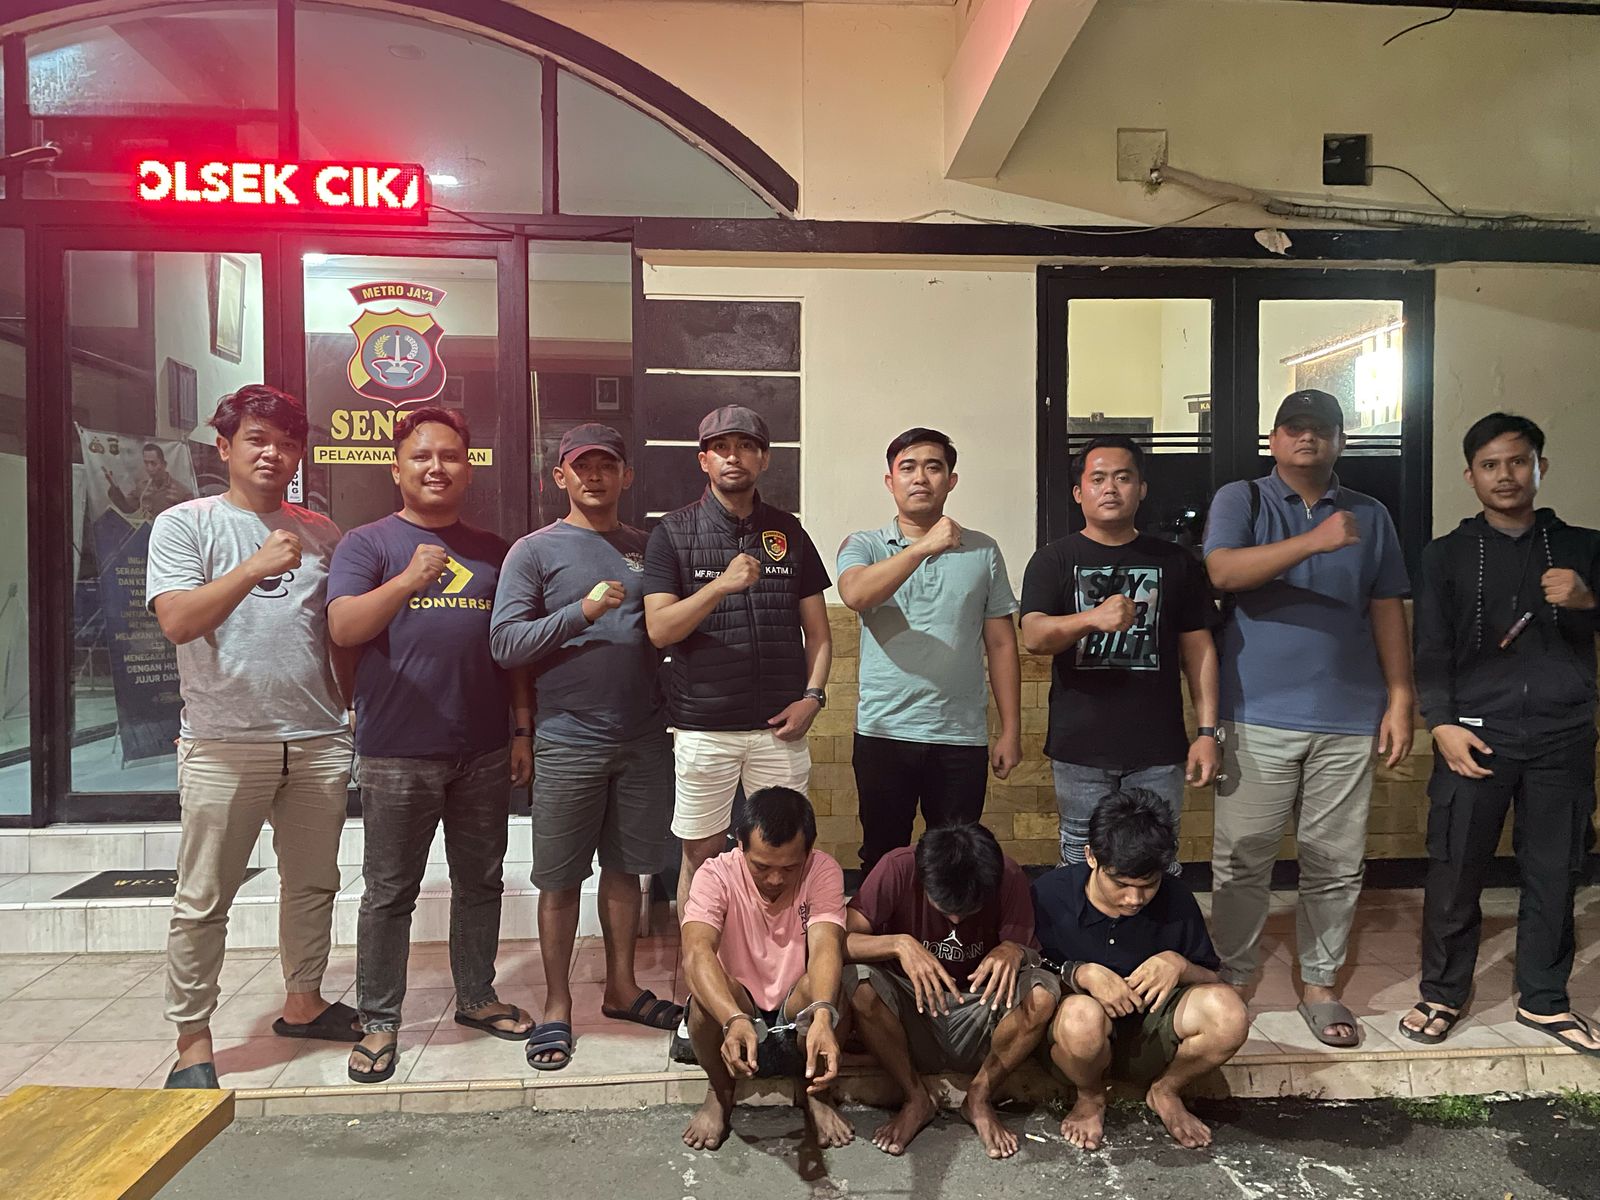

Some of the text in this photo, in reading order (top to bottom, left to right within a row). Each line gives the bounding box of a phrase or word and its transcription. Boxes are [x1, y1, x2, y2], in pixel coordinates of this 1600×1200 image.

[362, 285, 433, 302] METRO JAYA
[331, 409, 415, 441] SEN
[468, 451, 486, 462] AN
[291, 473, 299, 494] ONG
[765, 566, 789, 575] KATIM
[1087, 572, 1149, 601] SPY
[409, 597, 492, 610] CONVERSE
[127, 664, 161, 674] DENGAN
[134, 675, 160, 685] JUJUR
